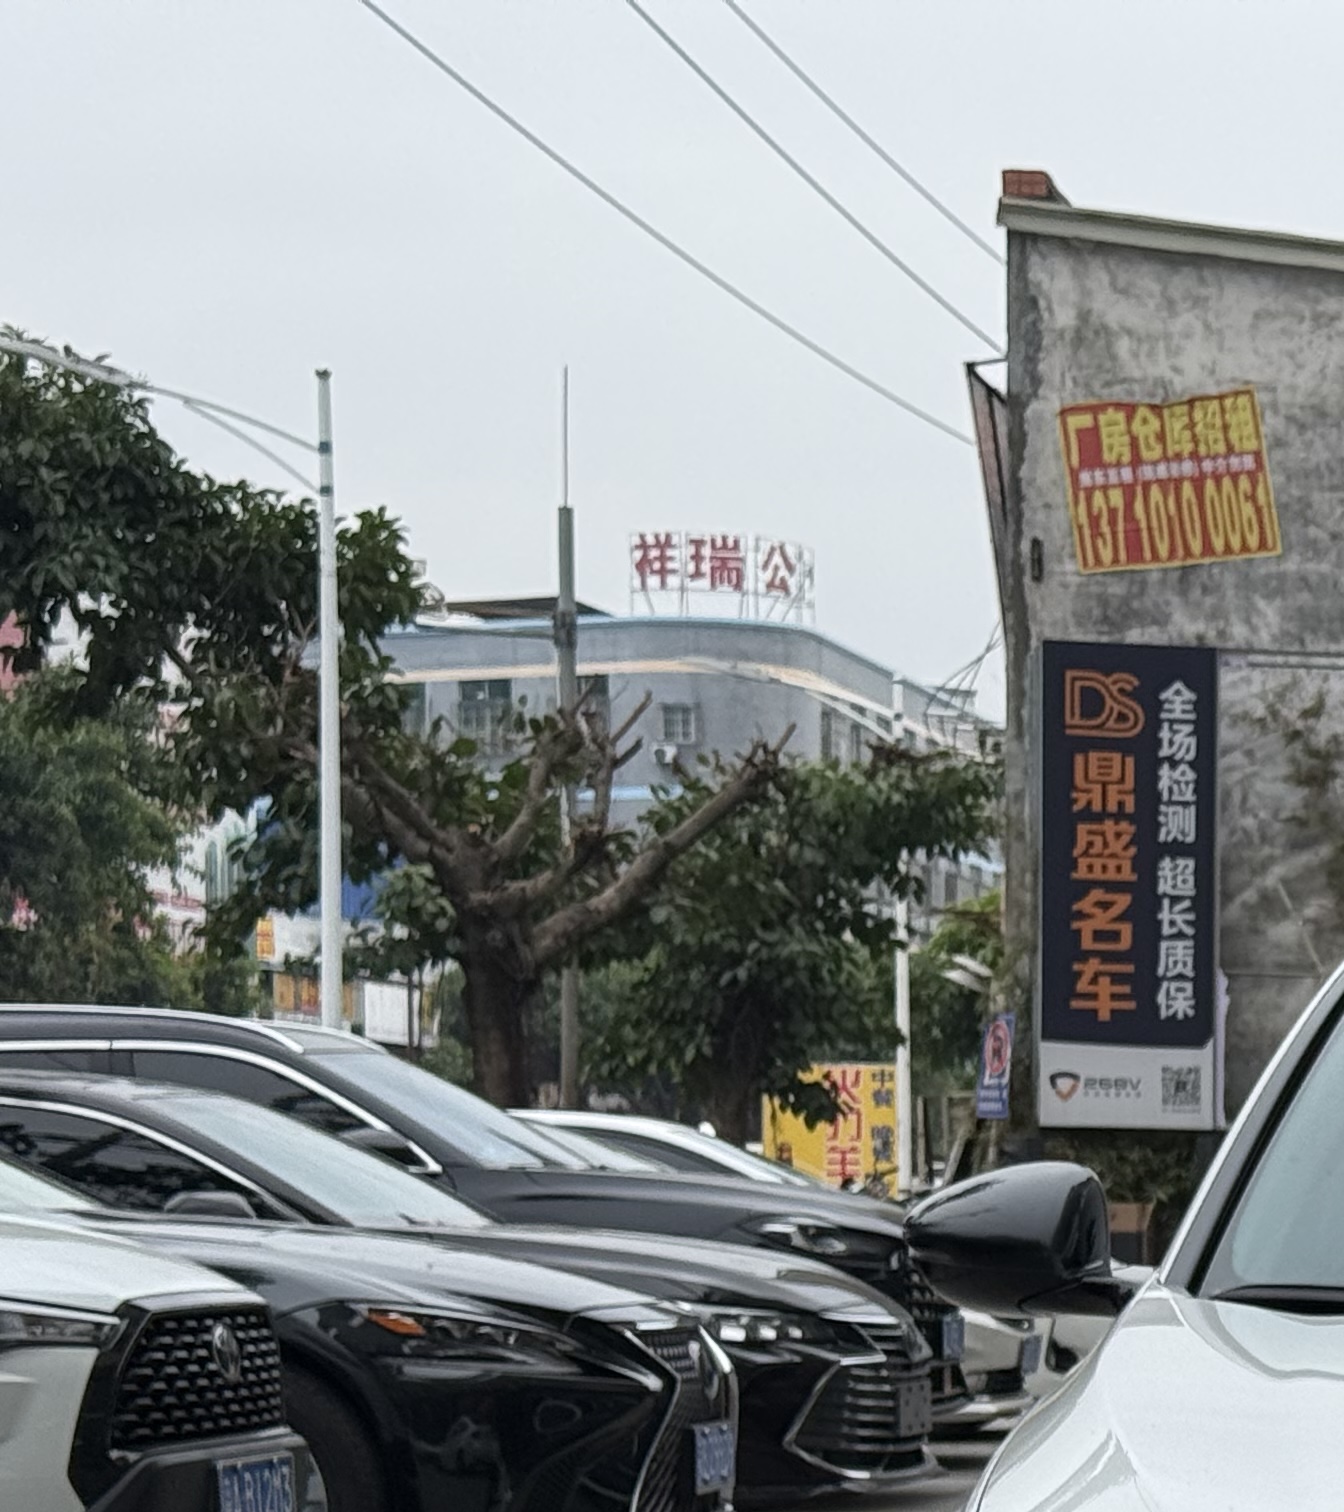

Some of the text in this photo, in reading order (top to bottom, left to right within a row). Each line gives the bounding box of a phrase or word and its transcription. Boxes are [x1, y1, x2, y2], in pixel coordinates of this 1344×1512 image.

[1066, 394, 1259, 467] 厂房仓库招租
[1078, 472, 1275, 567] 137 1010 0061
[1064, 668, 1145, 738] DS
[1069, 750, 1138, 1023] 鼎盛名车
[1155, 679, 1198, 1021] 全场检测 超长质保
